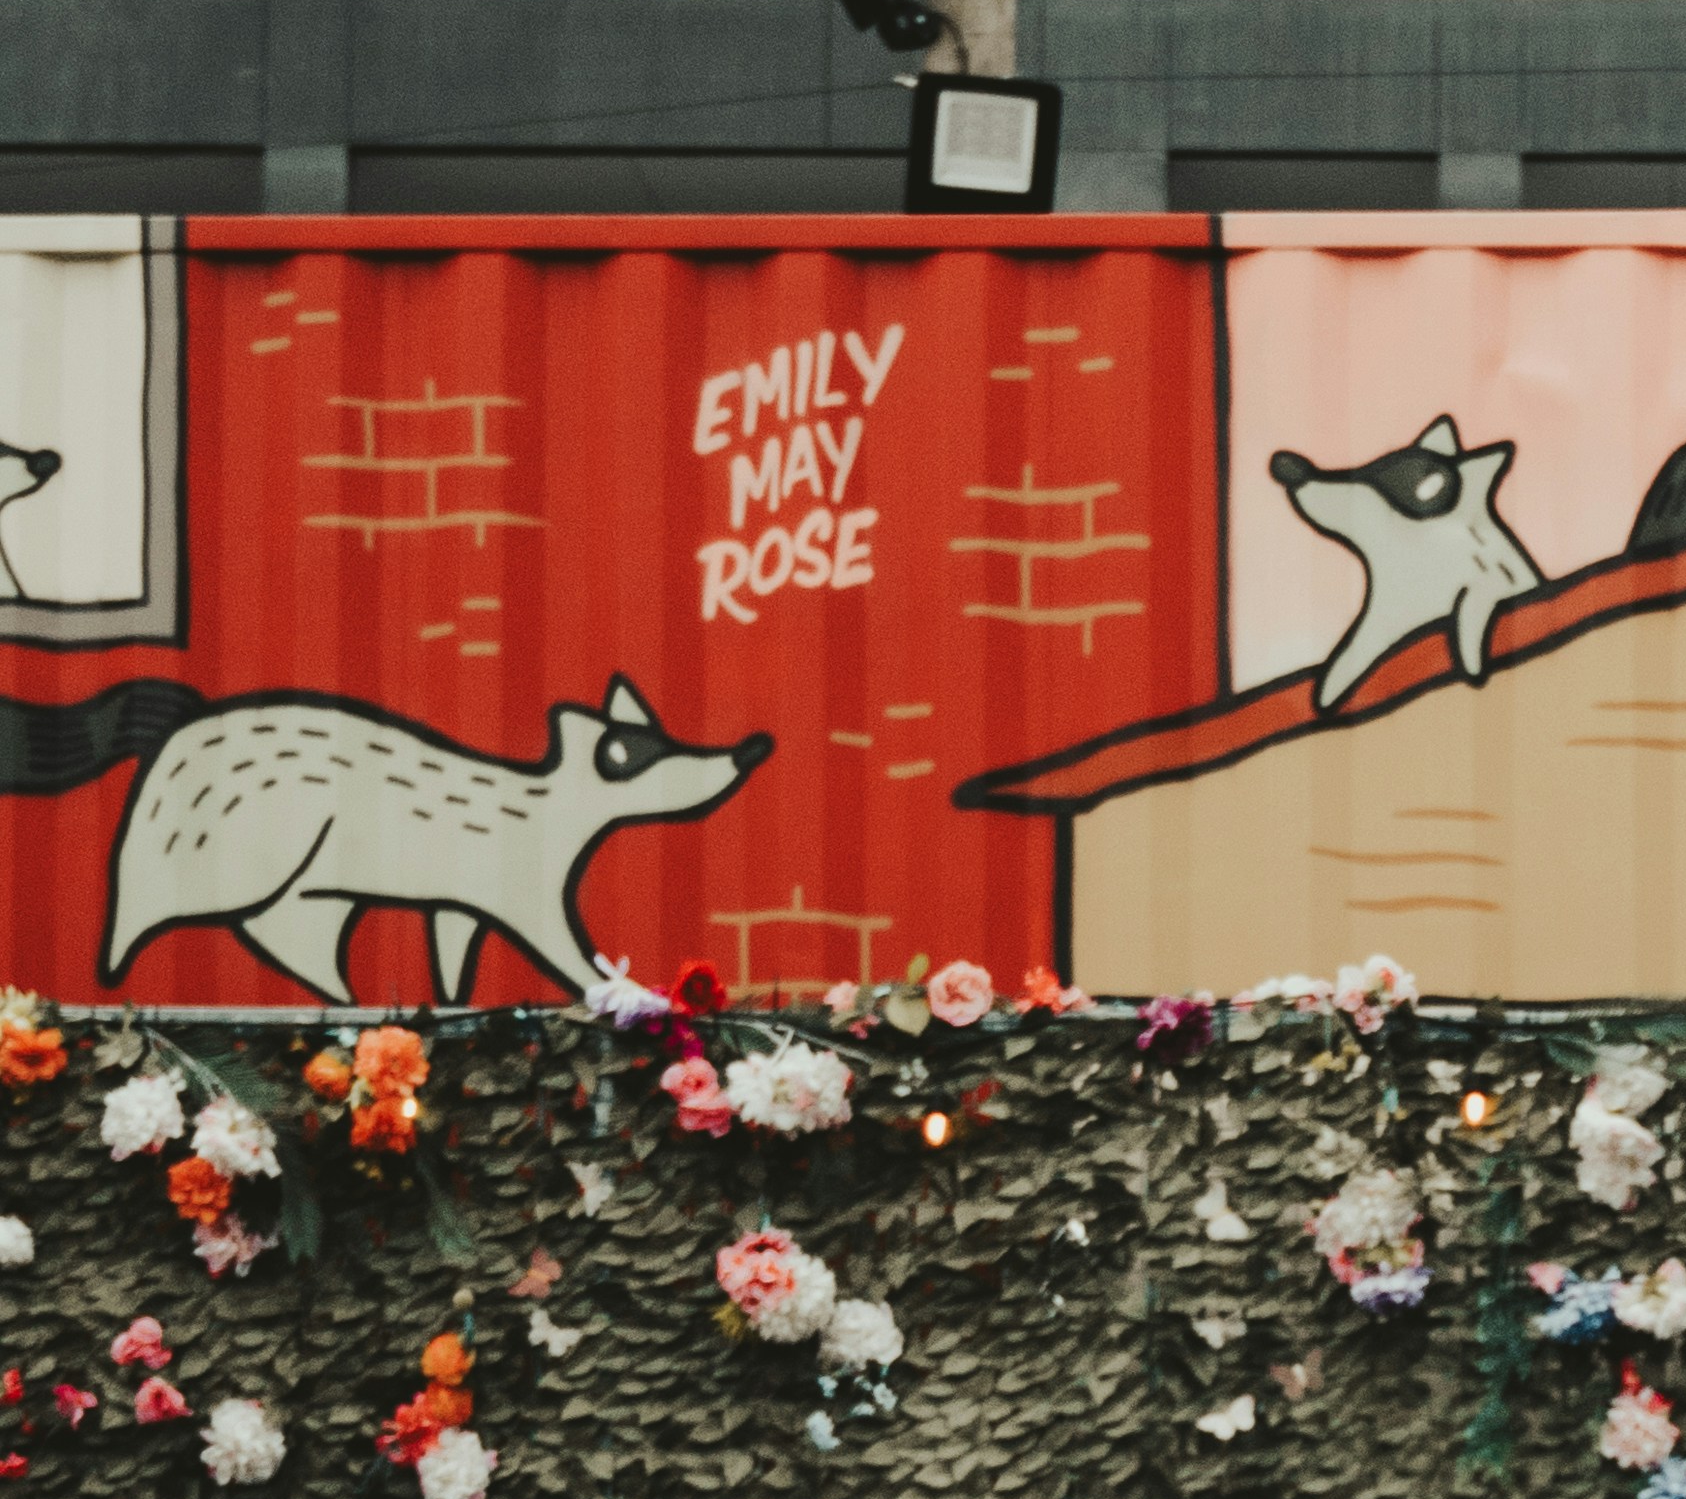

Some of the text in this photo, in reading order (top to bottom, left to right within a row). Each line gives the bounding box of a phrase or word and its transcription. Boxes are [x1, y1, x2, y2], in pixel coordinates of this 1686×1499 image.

[693, 323, 904, 454] EMILY
[729, 417, 863, 529] MAY
[697, 507, 879, 623] ROSE
